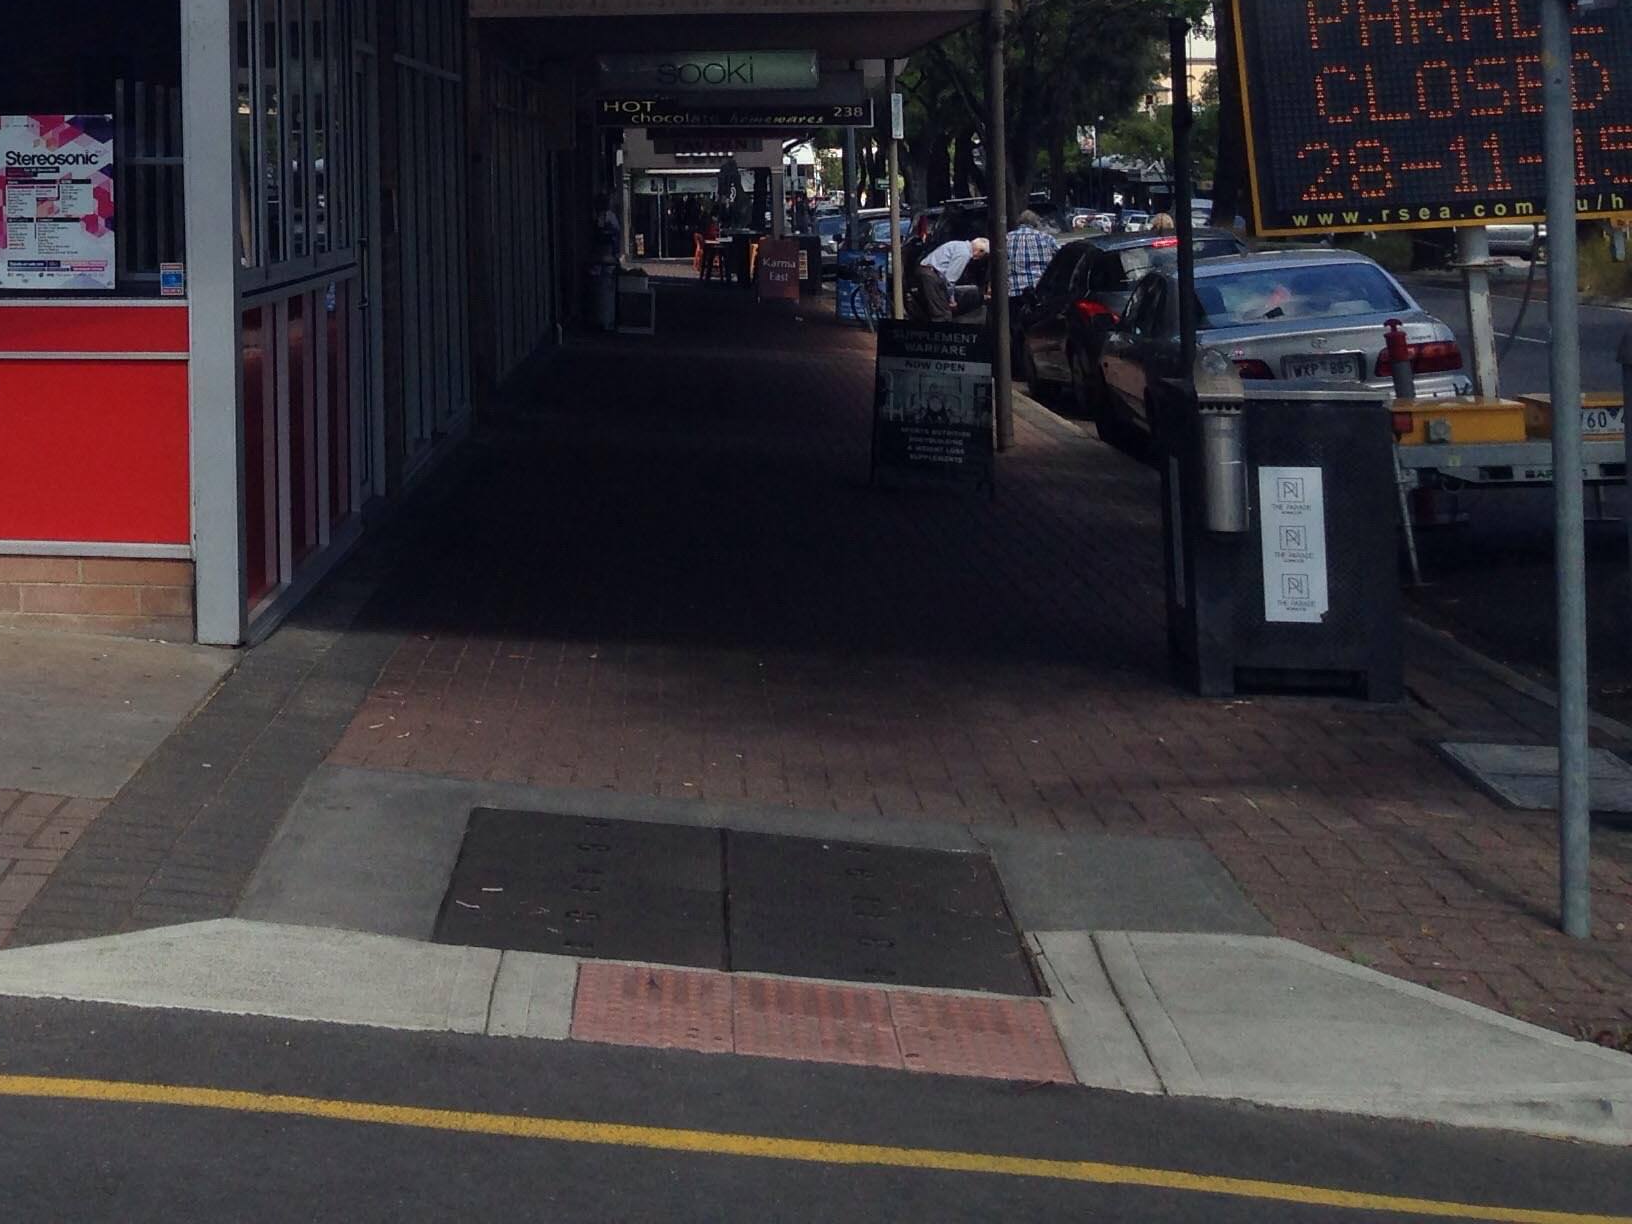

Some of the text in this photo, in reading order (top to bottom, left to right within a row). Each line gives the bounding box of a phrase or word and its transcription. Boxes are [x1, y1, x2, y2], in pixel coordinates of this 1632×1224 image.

[657, 56, 754, 85] sooki
[1316, 51, 1611, 125] CLOSED
[604, 101, 656, 112] HOT
[729, 113, 824, 125] homewares
[833, 106, 863, 118] 238
[6, 151, 98, 165] Stereosonic
[904, 343, 967, 356] WARFARE
[905, 359, 966, 372] NOW OPEN
